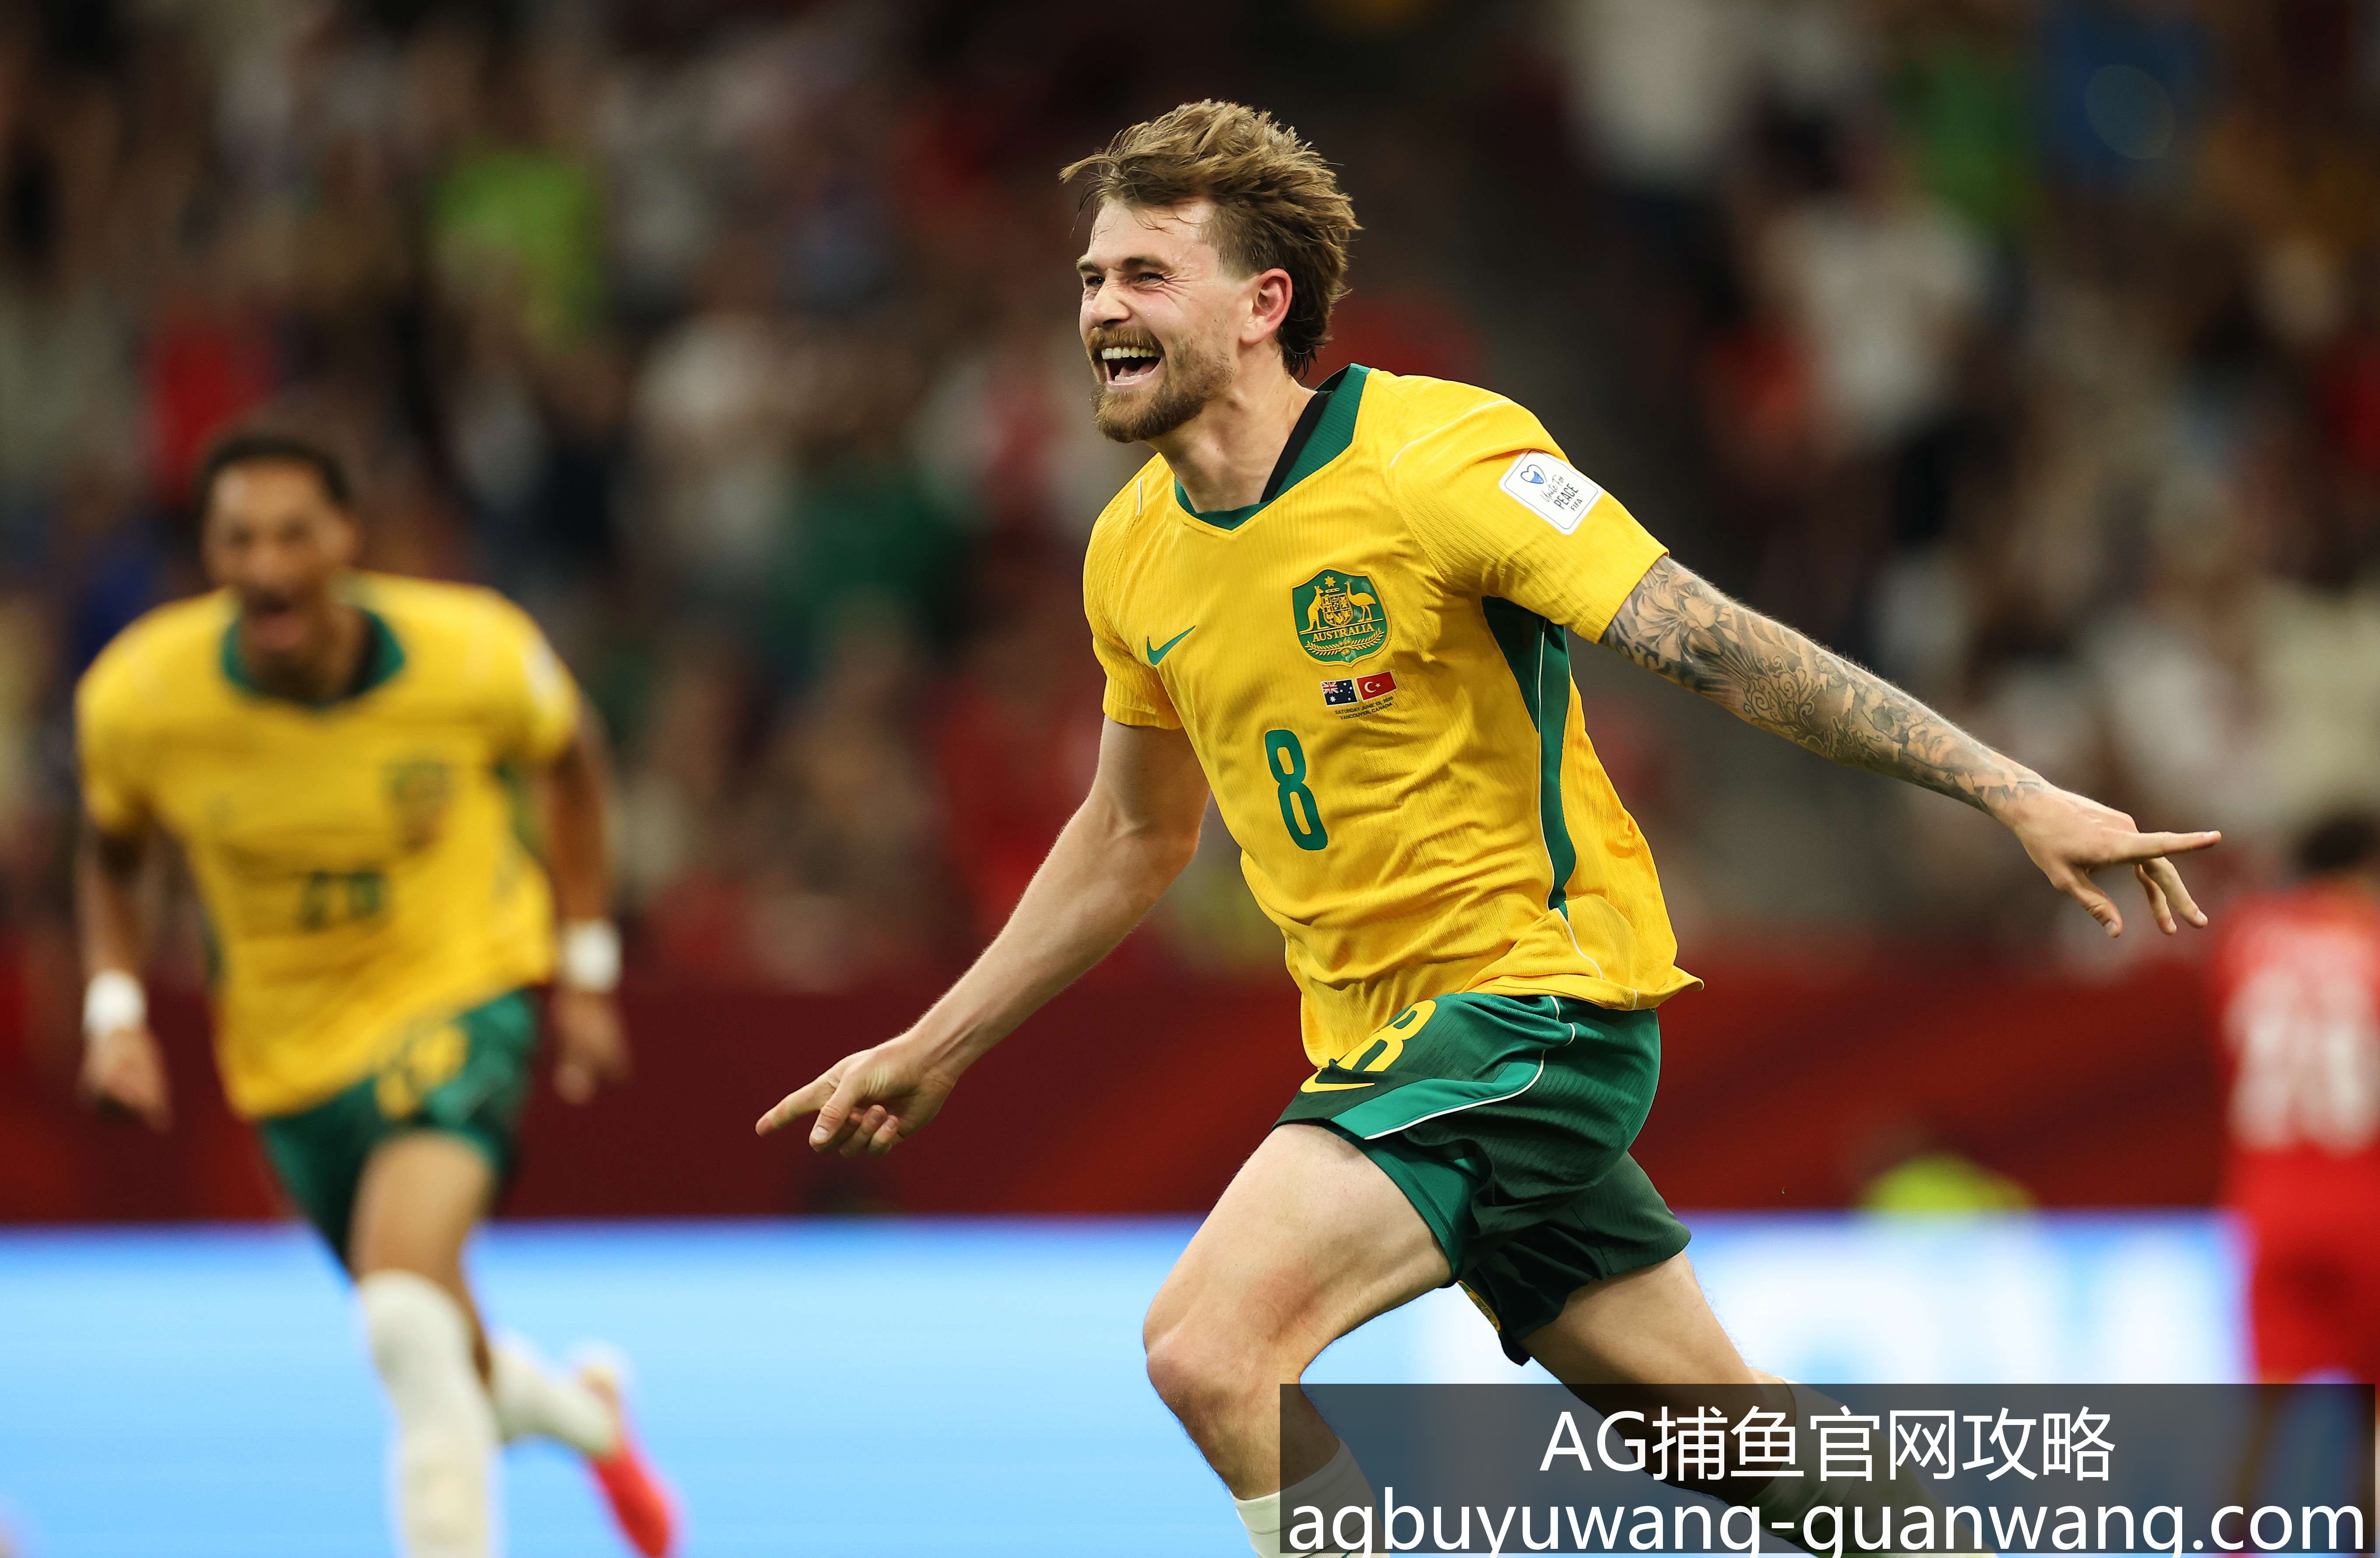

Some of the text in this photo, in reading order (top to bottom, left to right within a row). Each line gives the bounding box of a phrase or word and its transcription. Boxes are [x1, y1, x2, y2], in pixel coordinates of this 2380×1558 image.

[1554, 483, 1579, 510] PEACE
[1570, 499, 1583, 512] FIFA
[1312, 623, 1375, 643] AUSTRALIA
[1371, 702, 1392, 713] CANADA
[1265, 729, 1328, 851] 8
